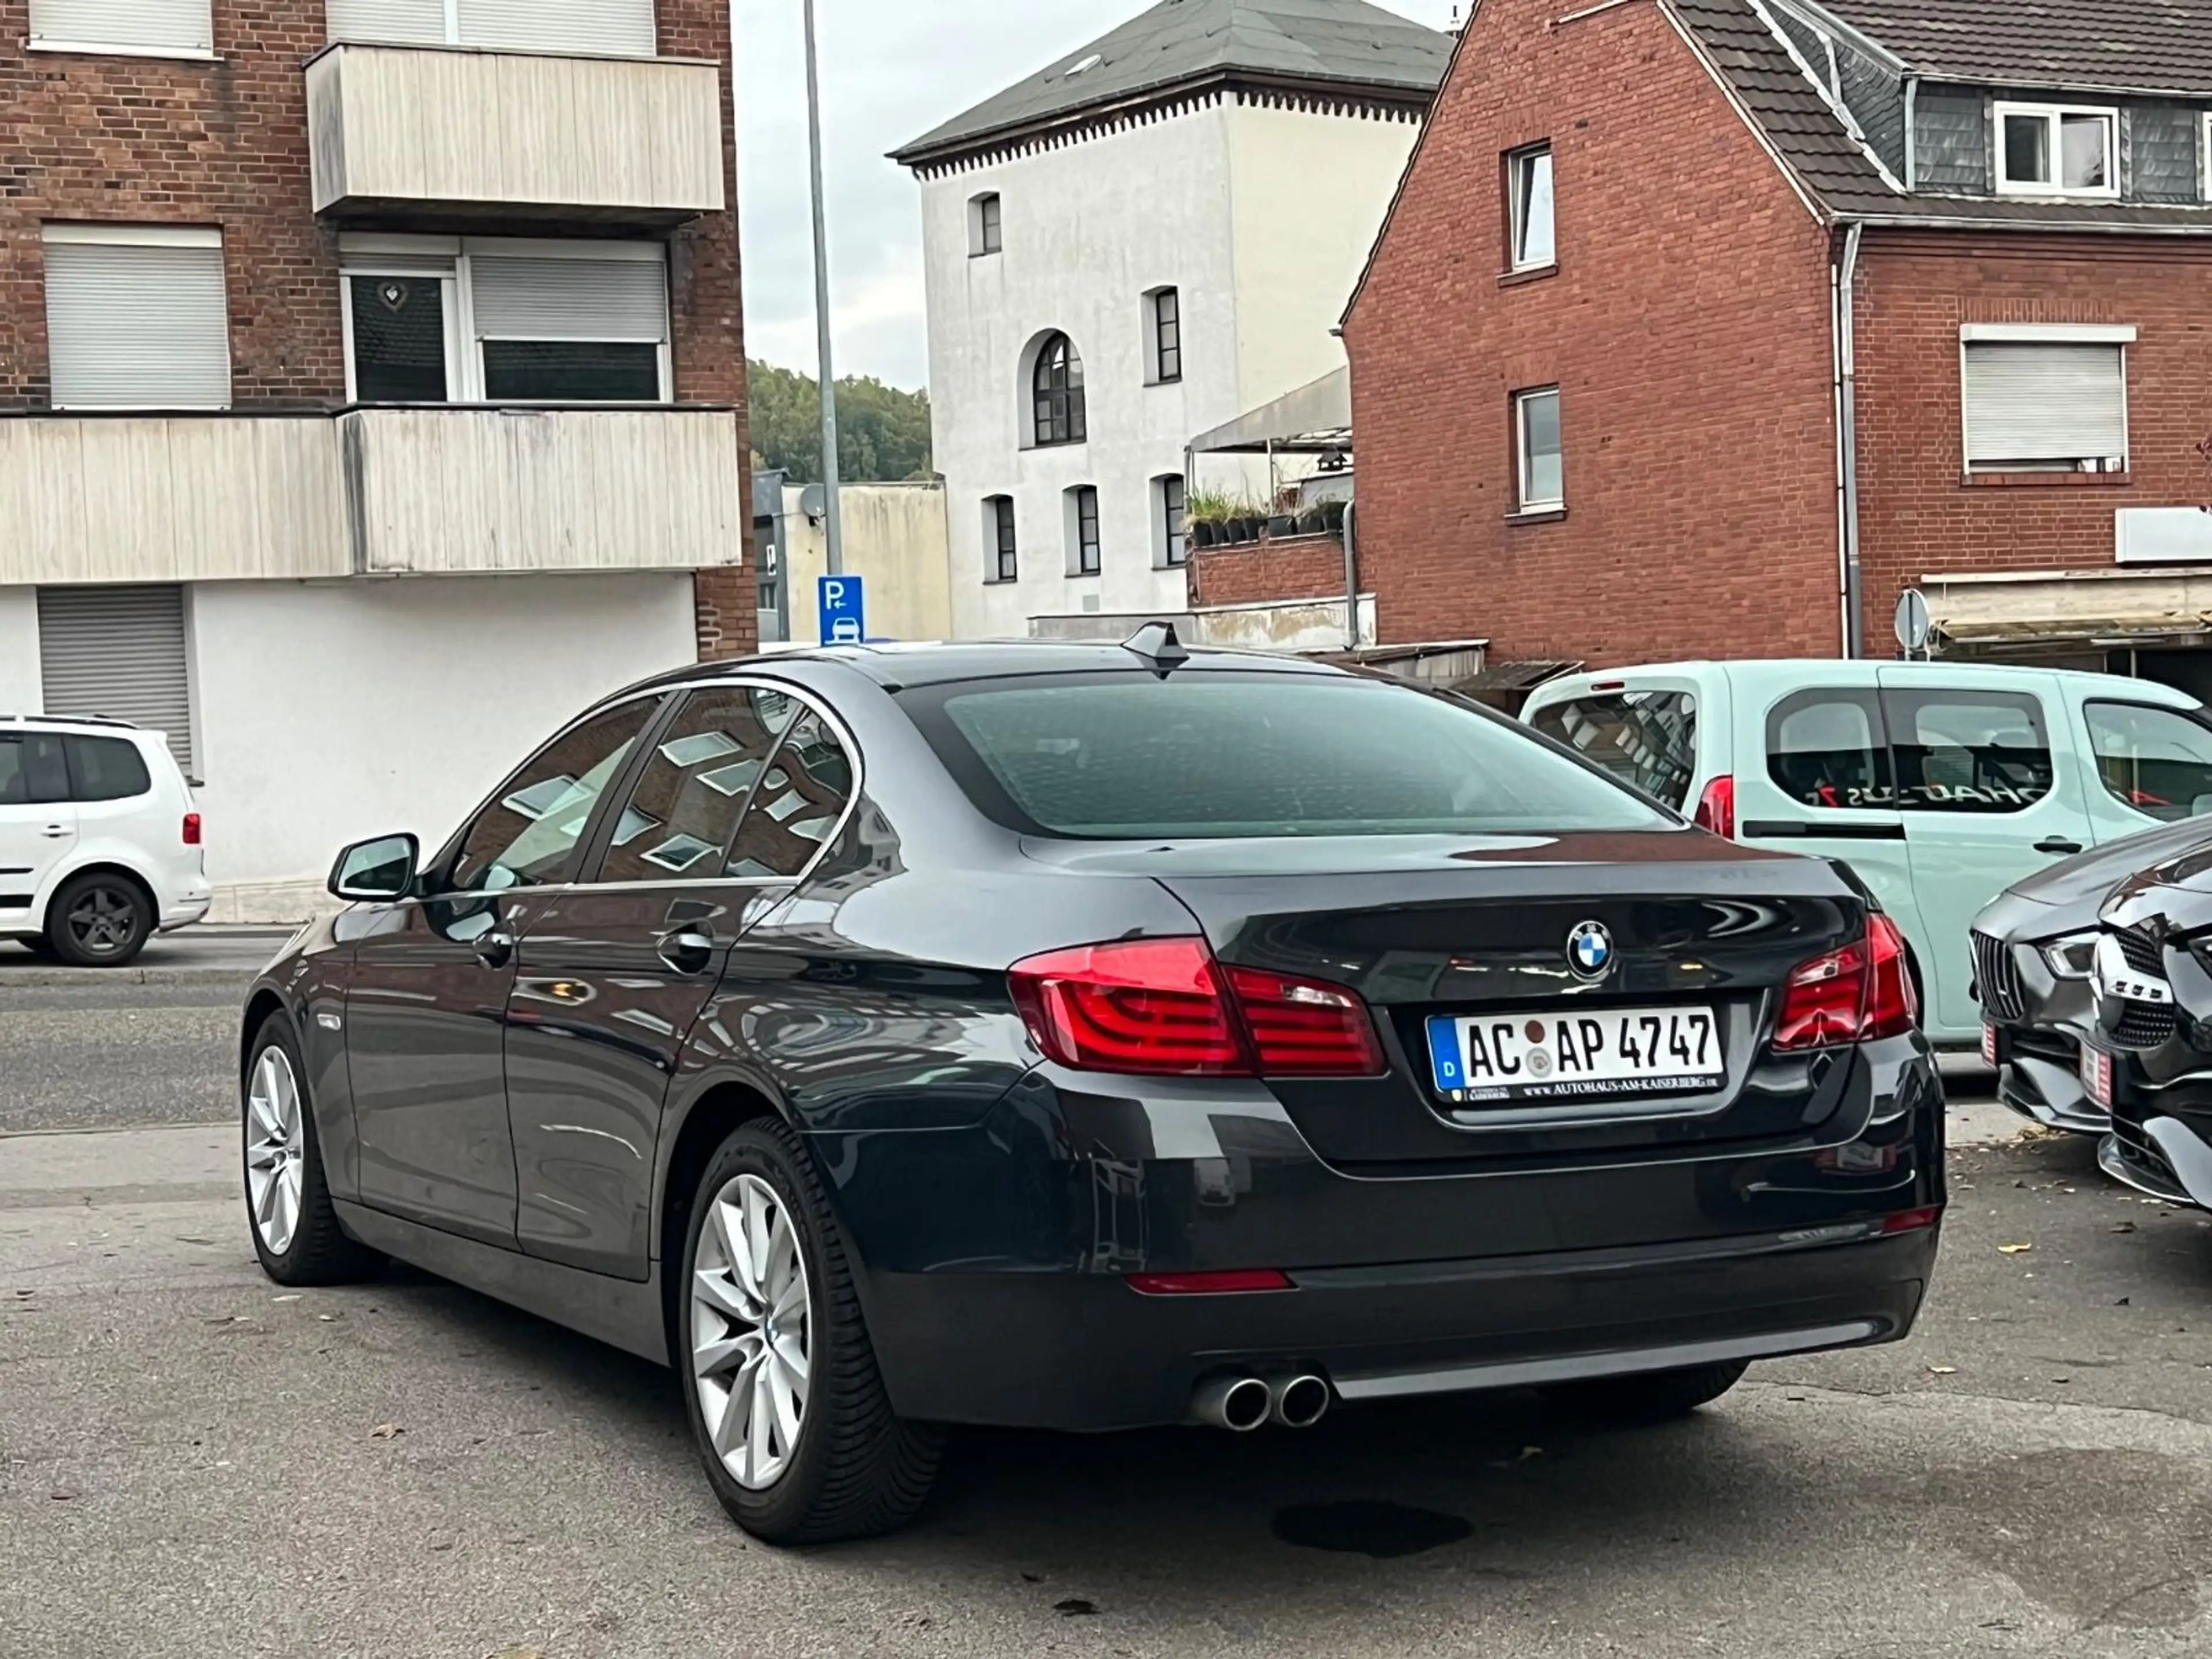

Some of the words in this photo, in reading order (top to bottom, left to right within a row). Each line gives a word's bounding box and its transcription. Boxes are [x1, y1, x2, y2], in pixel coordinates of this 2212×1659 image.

[825, 581, 844, 609] P
[1469, 1023, 1521, 1078] AC
[1558, 1019, 1604, 1072] AP
[1619, 1014, 1710, 1068] 4747
[1444, 1062, 1455, 1077] D
